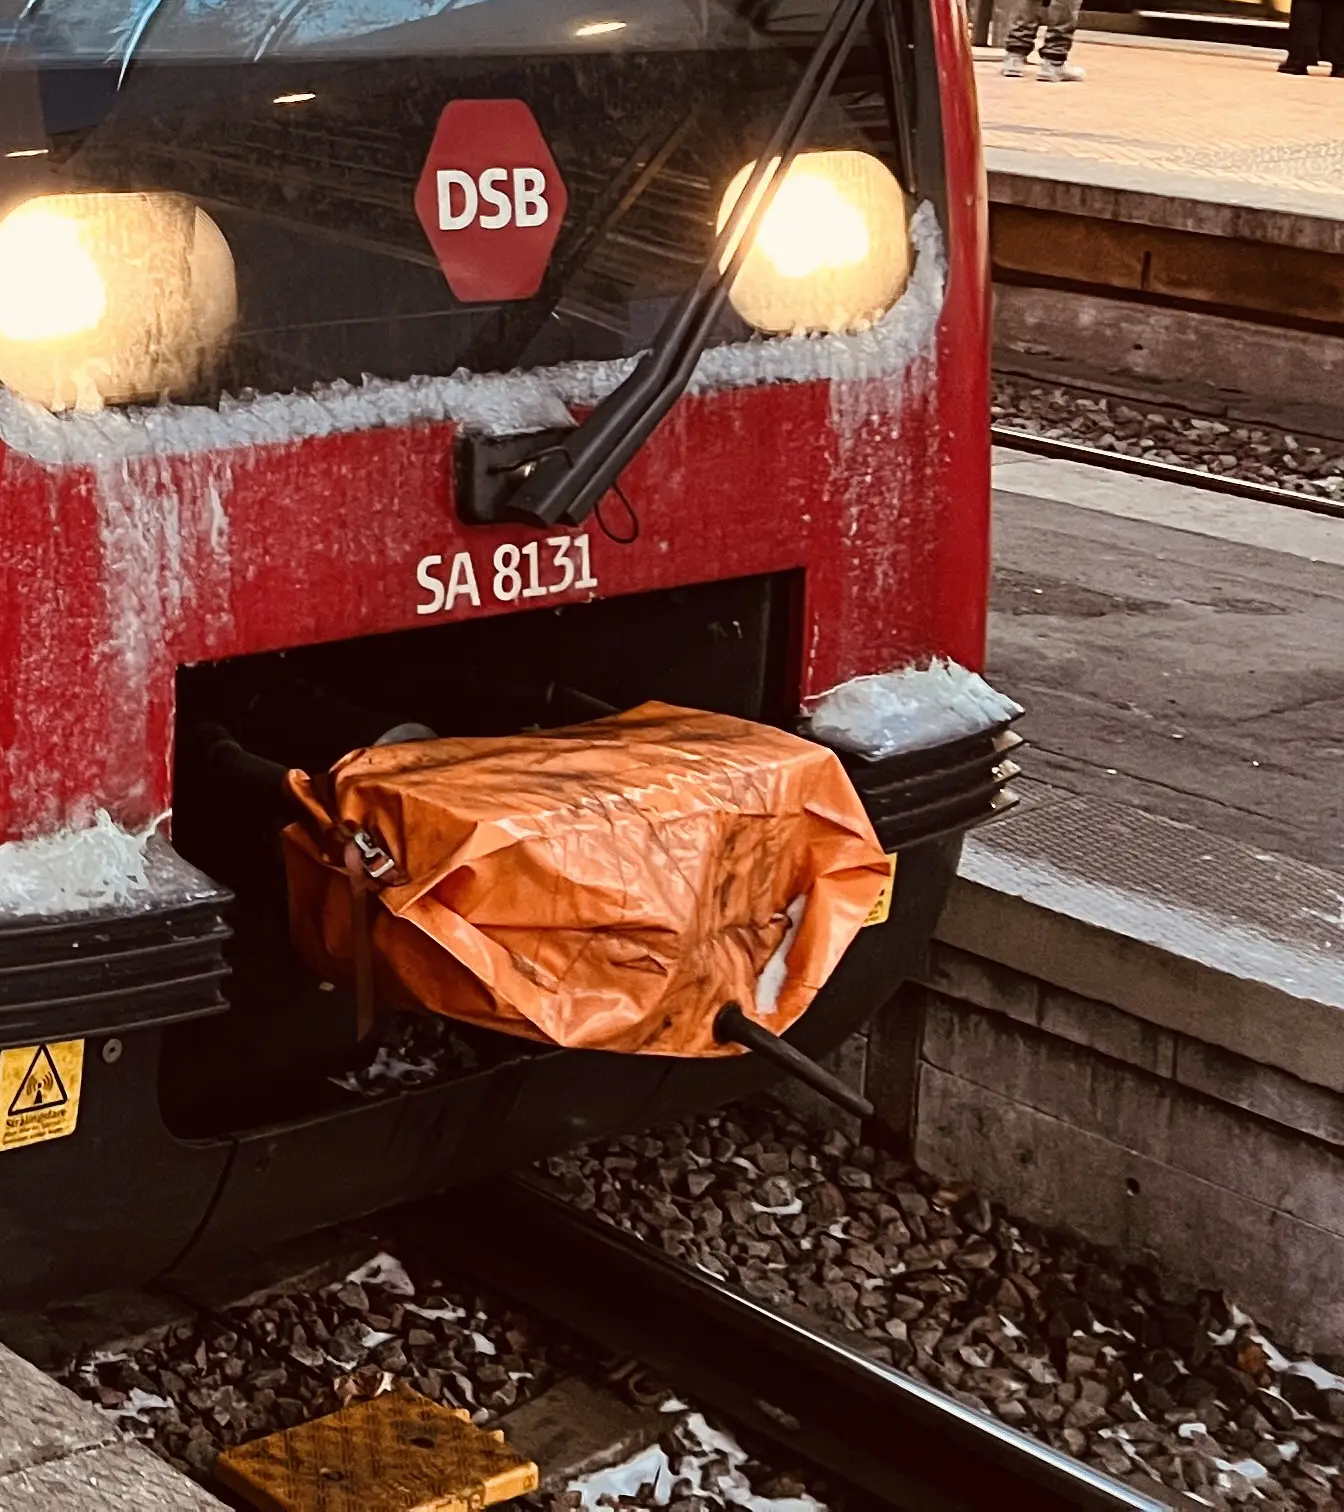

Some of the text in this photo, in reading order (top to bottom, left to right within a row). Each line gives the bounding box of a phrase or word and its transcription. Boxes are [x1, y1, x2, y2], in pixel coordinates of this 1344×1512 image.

[436, 167, 549, 230] DSB
[416, 533, 598, 615] SA 8131
